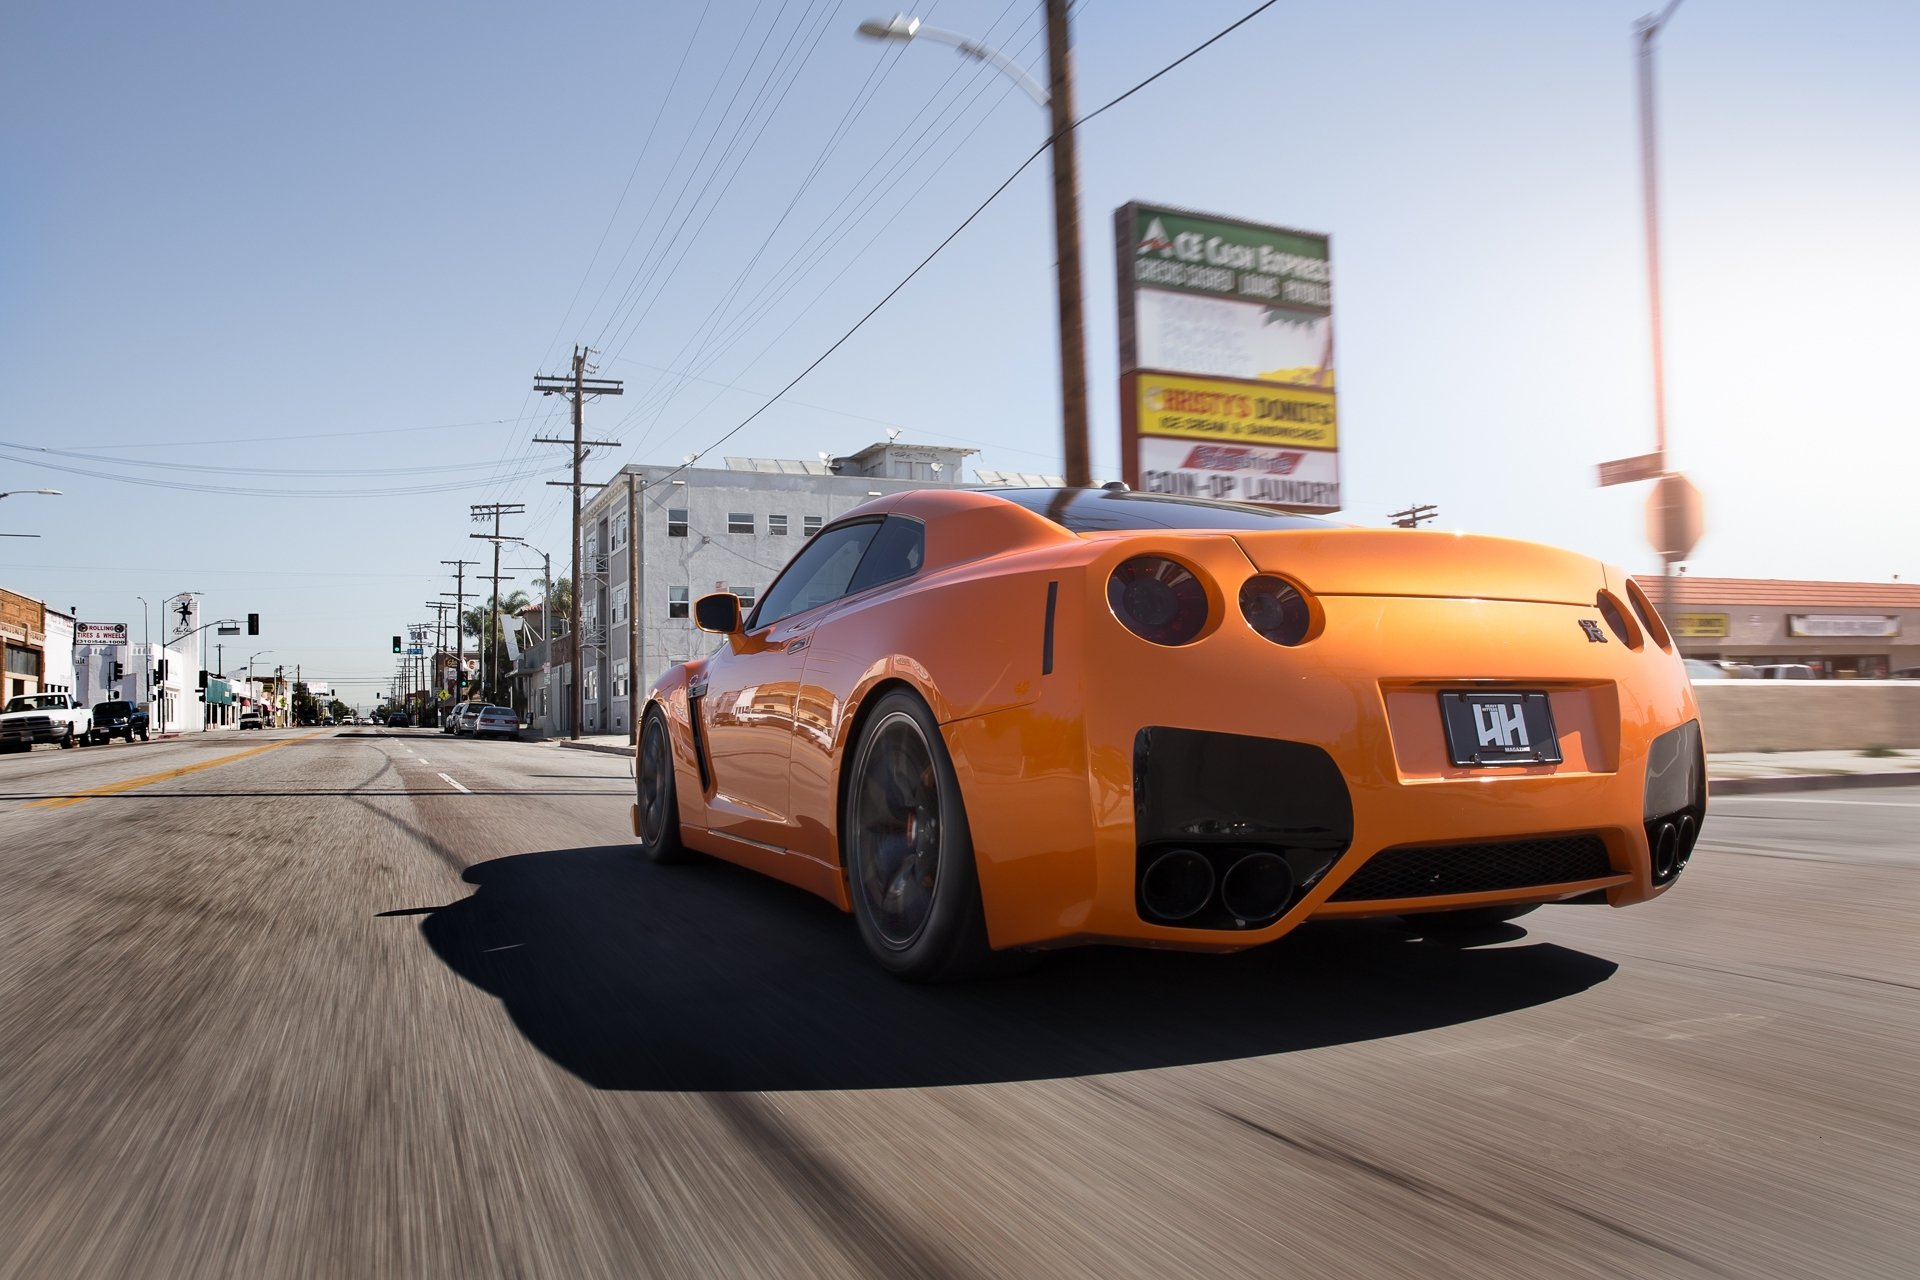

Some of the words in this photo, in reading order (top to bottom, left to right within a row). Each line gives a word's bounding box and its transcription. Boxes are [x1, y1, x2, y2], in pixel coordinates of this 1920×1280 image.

[1255, 397, 1334, 425] DONUTS
[1144, 469, 1236, 499] COIN-OP
[1242, 476, 1340, 505] LAUNDRY
